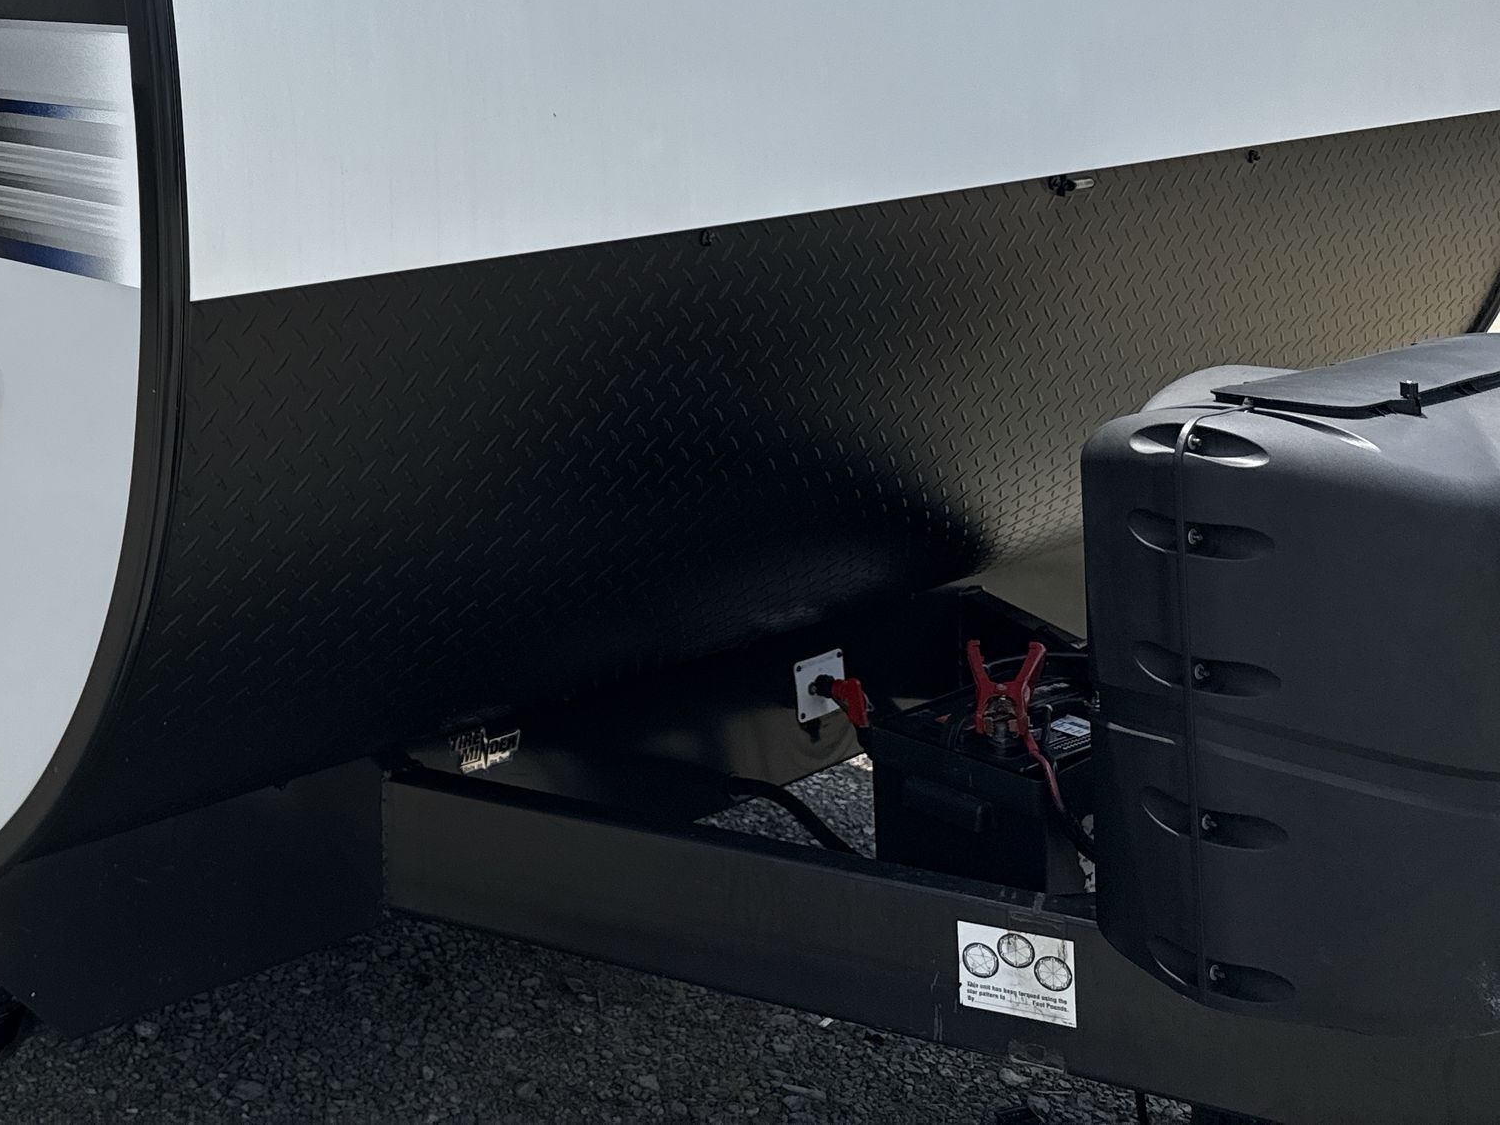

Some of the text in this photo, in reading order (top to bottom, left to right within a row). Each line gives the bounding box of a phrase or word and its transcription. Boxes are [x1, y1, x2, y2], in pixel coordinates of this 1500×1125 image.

[979, 991, 999, 999] pattern
[1032, 1000, 1046, 1008] Foot
[1019, 990, 1040, 999] torqued
[1041, 995, 1057, 1004] using
